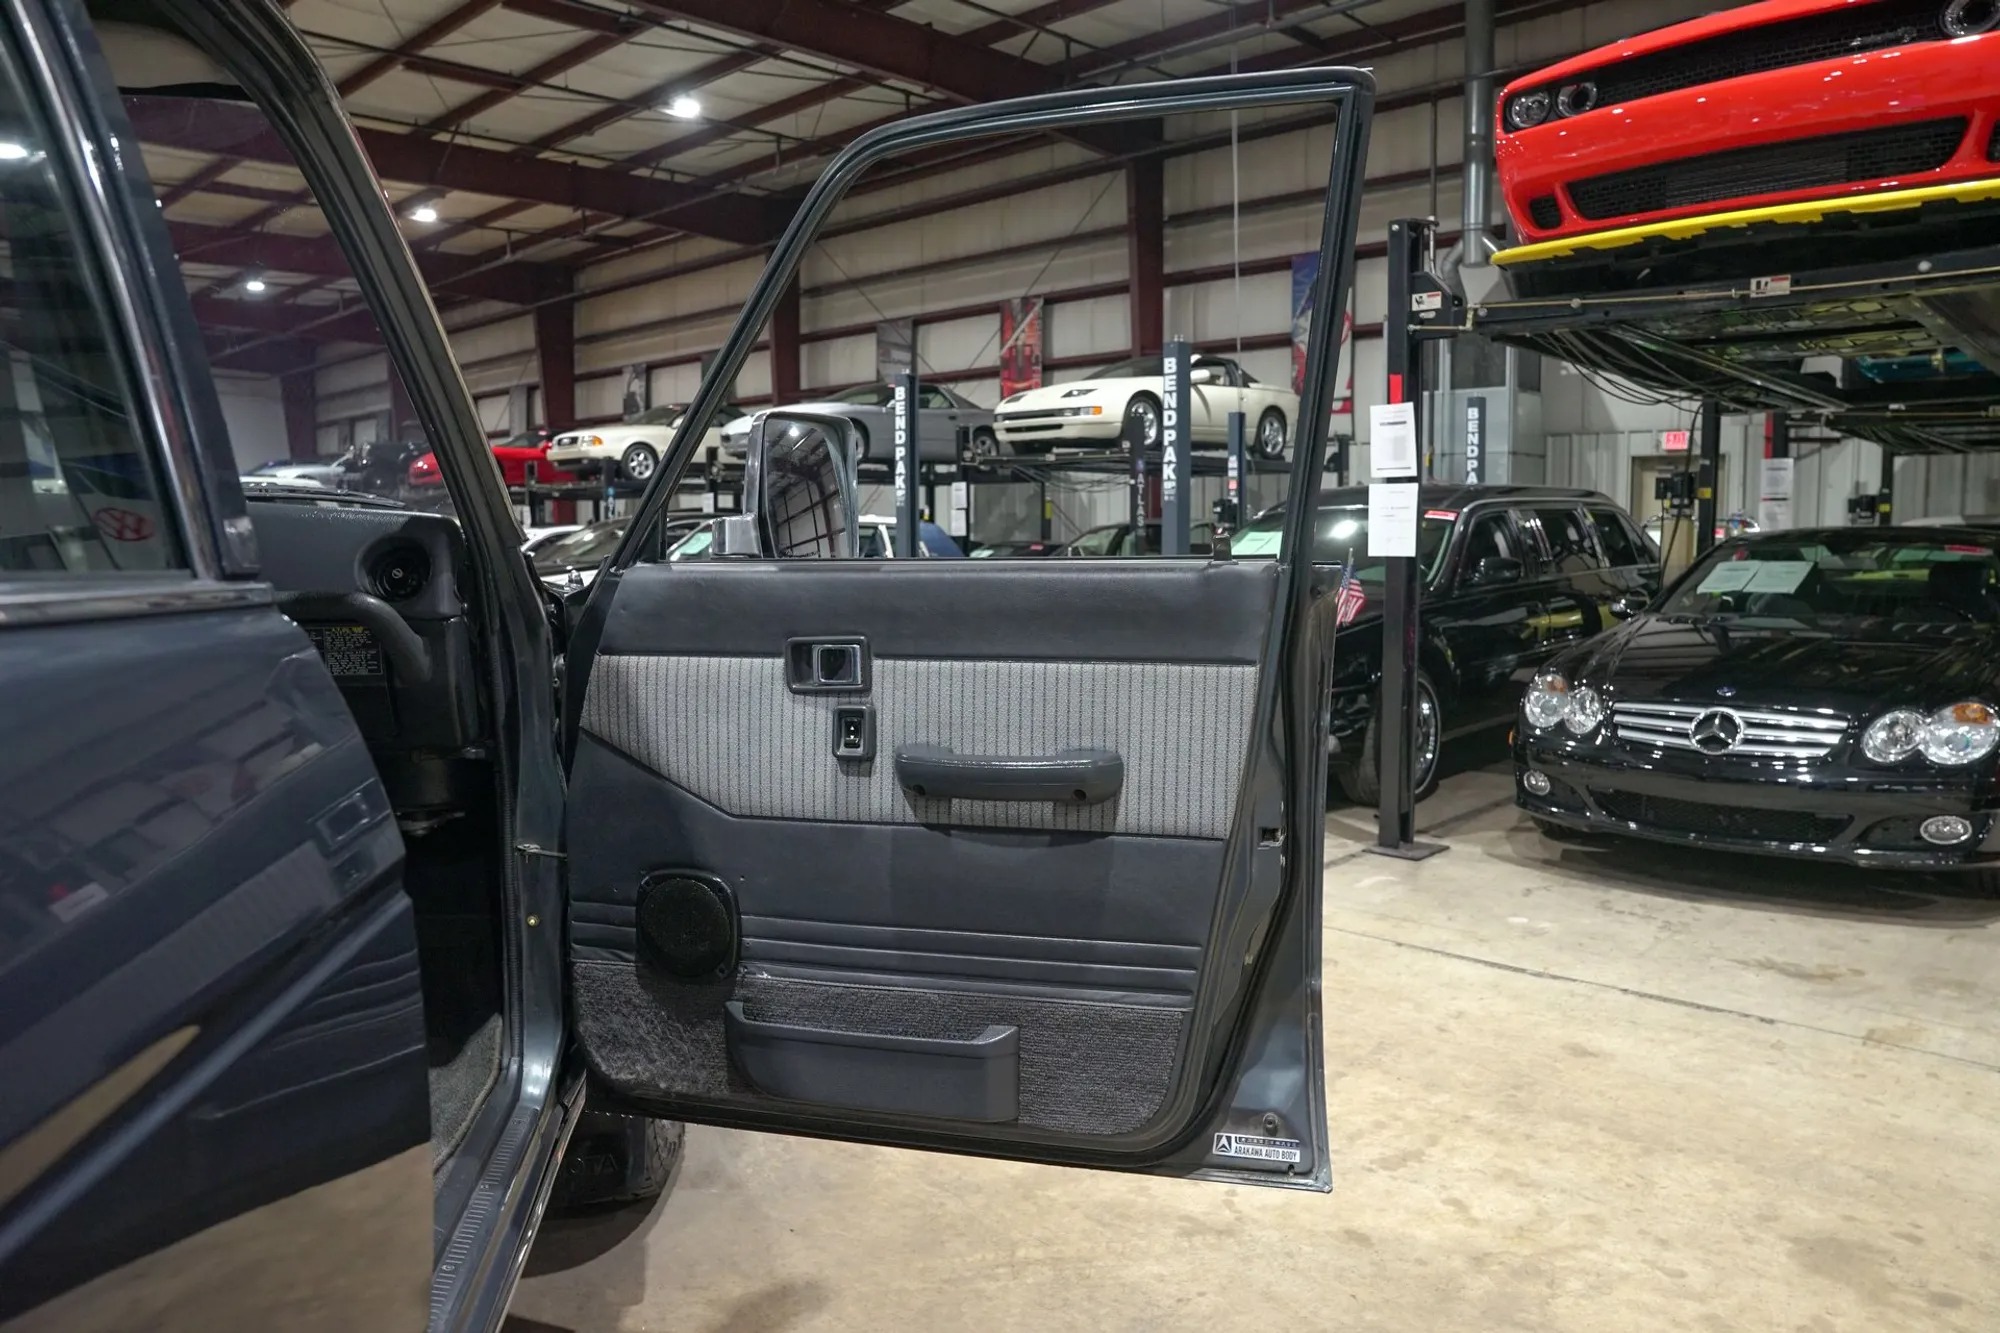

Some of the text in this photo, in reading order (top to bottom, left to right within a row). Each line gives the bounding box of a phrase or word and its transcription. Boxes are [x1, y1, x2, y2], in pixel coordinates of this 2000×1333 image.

[894, 386, 906, 489] BENDPAK
[1163, 357, 1177, 480] BENDPAK
[1466, 407, 1479, 485] BENDPA
[1137, 472, 1145, 527] ATLAS
[1234, 1145, 1297, 1161] ARAKAWA AUTO BODY
